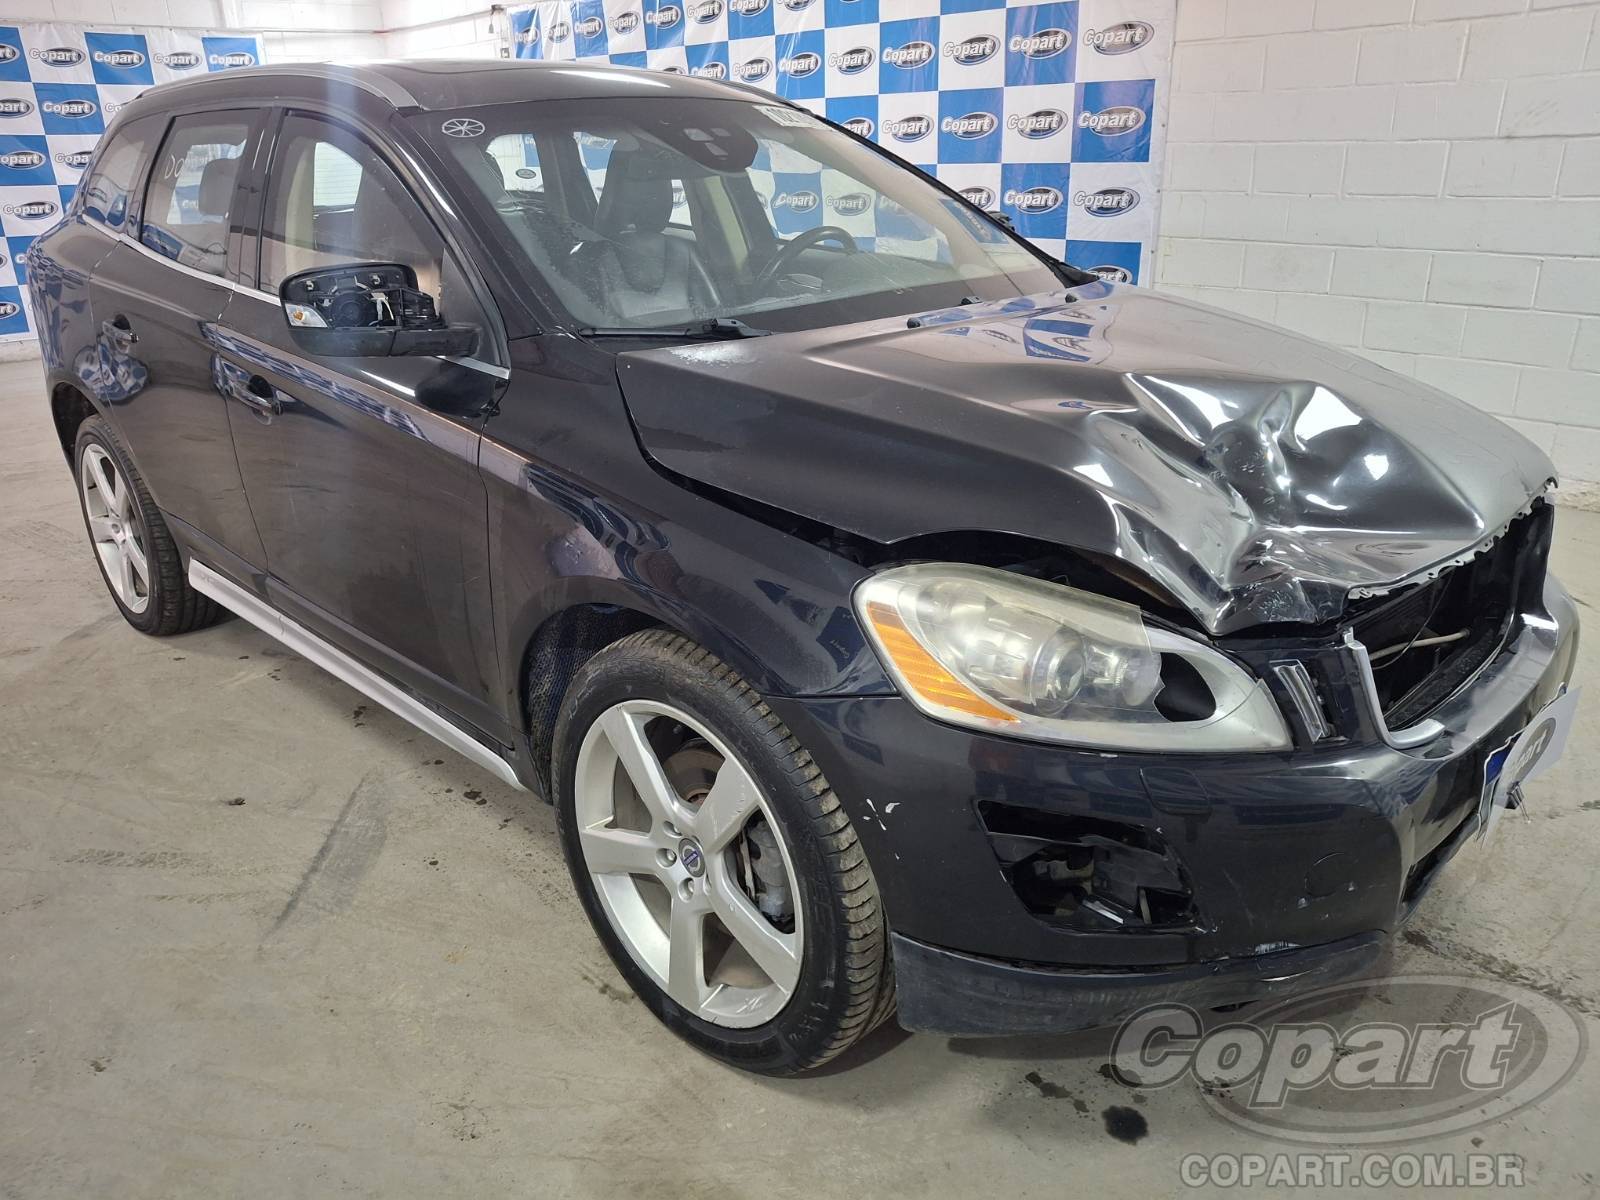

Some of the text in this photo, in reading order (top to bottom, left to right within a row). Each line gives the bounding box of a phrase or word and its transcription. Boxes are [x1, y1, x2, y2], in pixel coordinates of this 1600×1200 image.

[687, 0, 721, 20] Copart
[1009, 32, 1064, 54] Copart
[1083, 27, 1144, 49] Copart
[29, 48, 78, 63] Copart
[882, 44, 930, 65] Copart
[943, 38, 994, 59] Copart
[93, 50, 140, 65] Copart
[154, 53, 197, 65] Copart
[209, 54, 250, 66] Copart
[778, 57, 817, 74] Copart
[828, 52, 869, 69] Copart
[732, 60, 767, 79] Copart
[42, 101, 90, 115] Copart
[882, 118, 929, 135] Copart
[941, 114, 991, 134] Copart
[1007, 113, 1059, 132] Copart
[1078, 111, 1137, 131] Copart
[0, 153, 40, 166] opart
[55, 153, 89, 166] Copa
[825, 195, 865, 209] Copart
[1003, 189, 1055, 208] Copart
[1074, 191, 1129, 210] Copart
[3, 204, 51, 217] Copart
